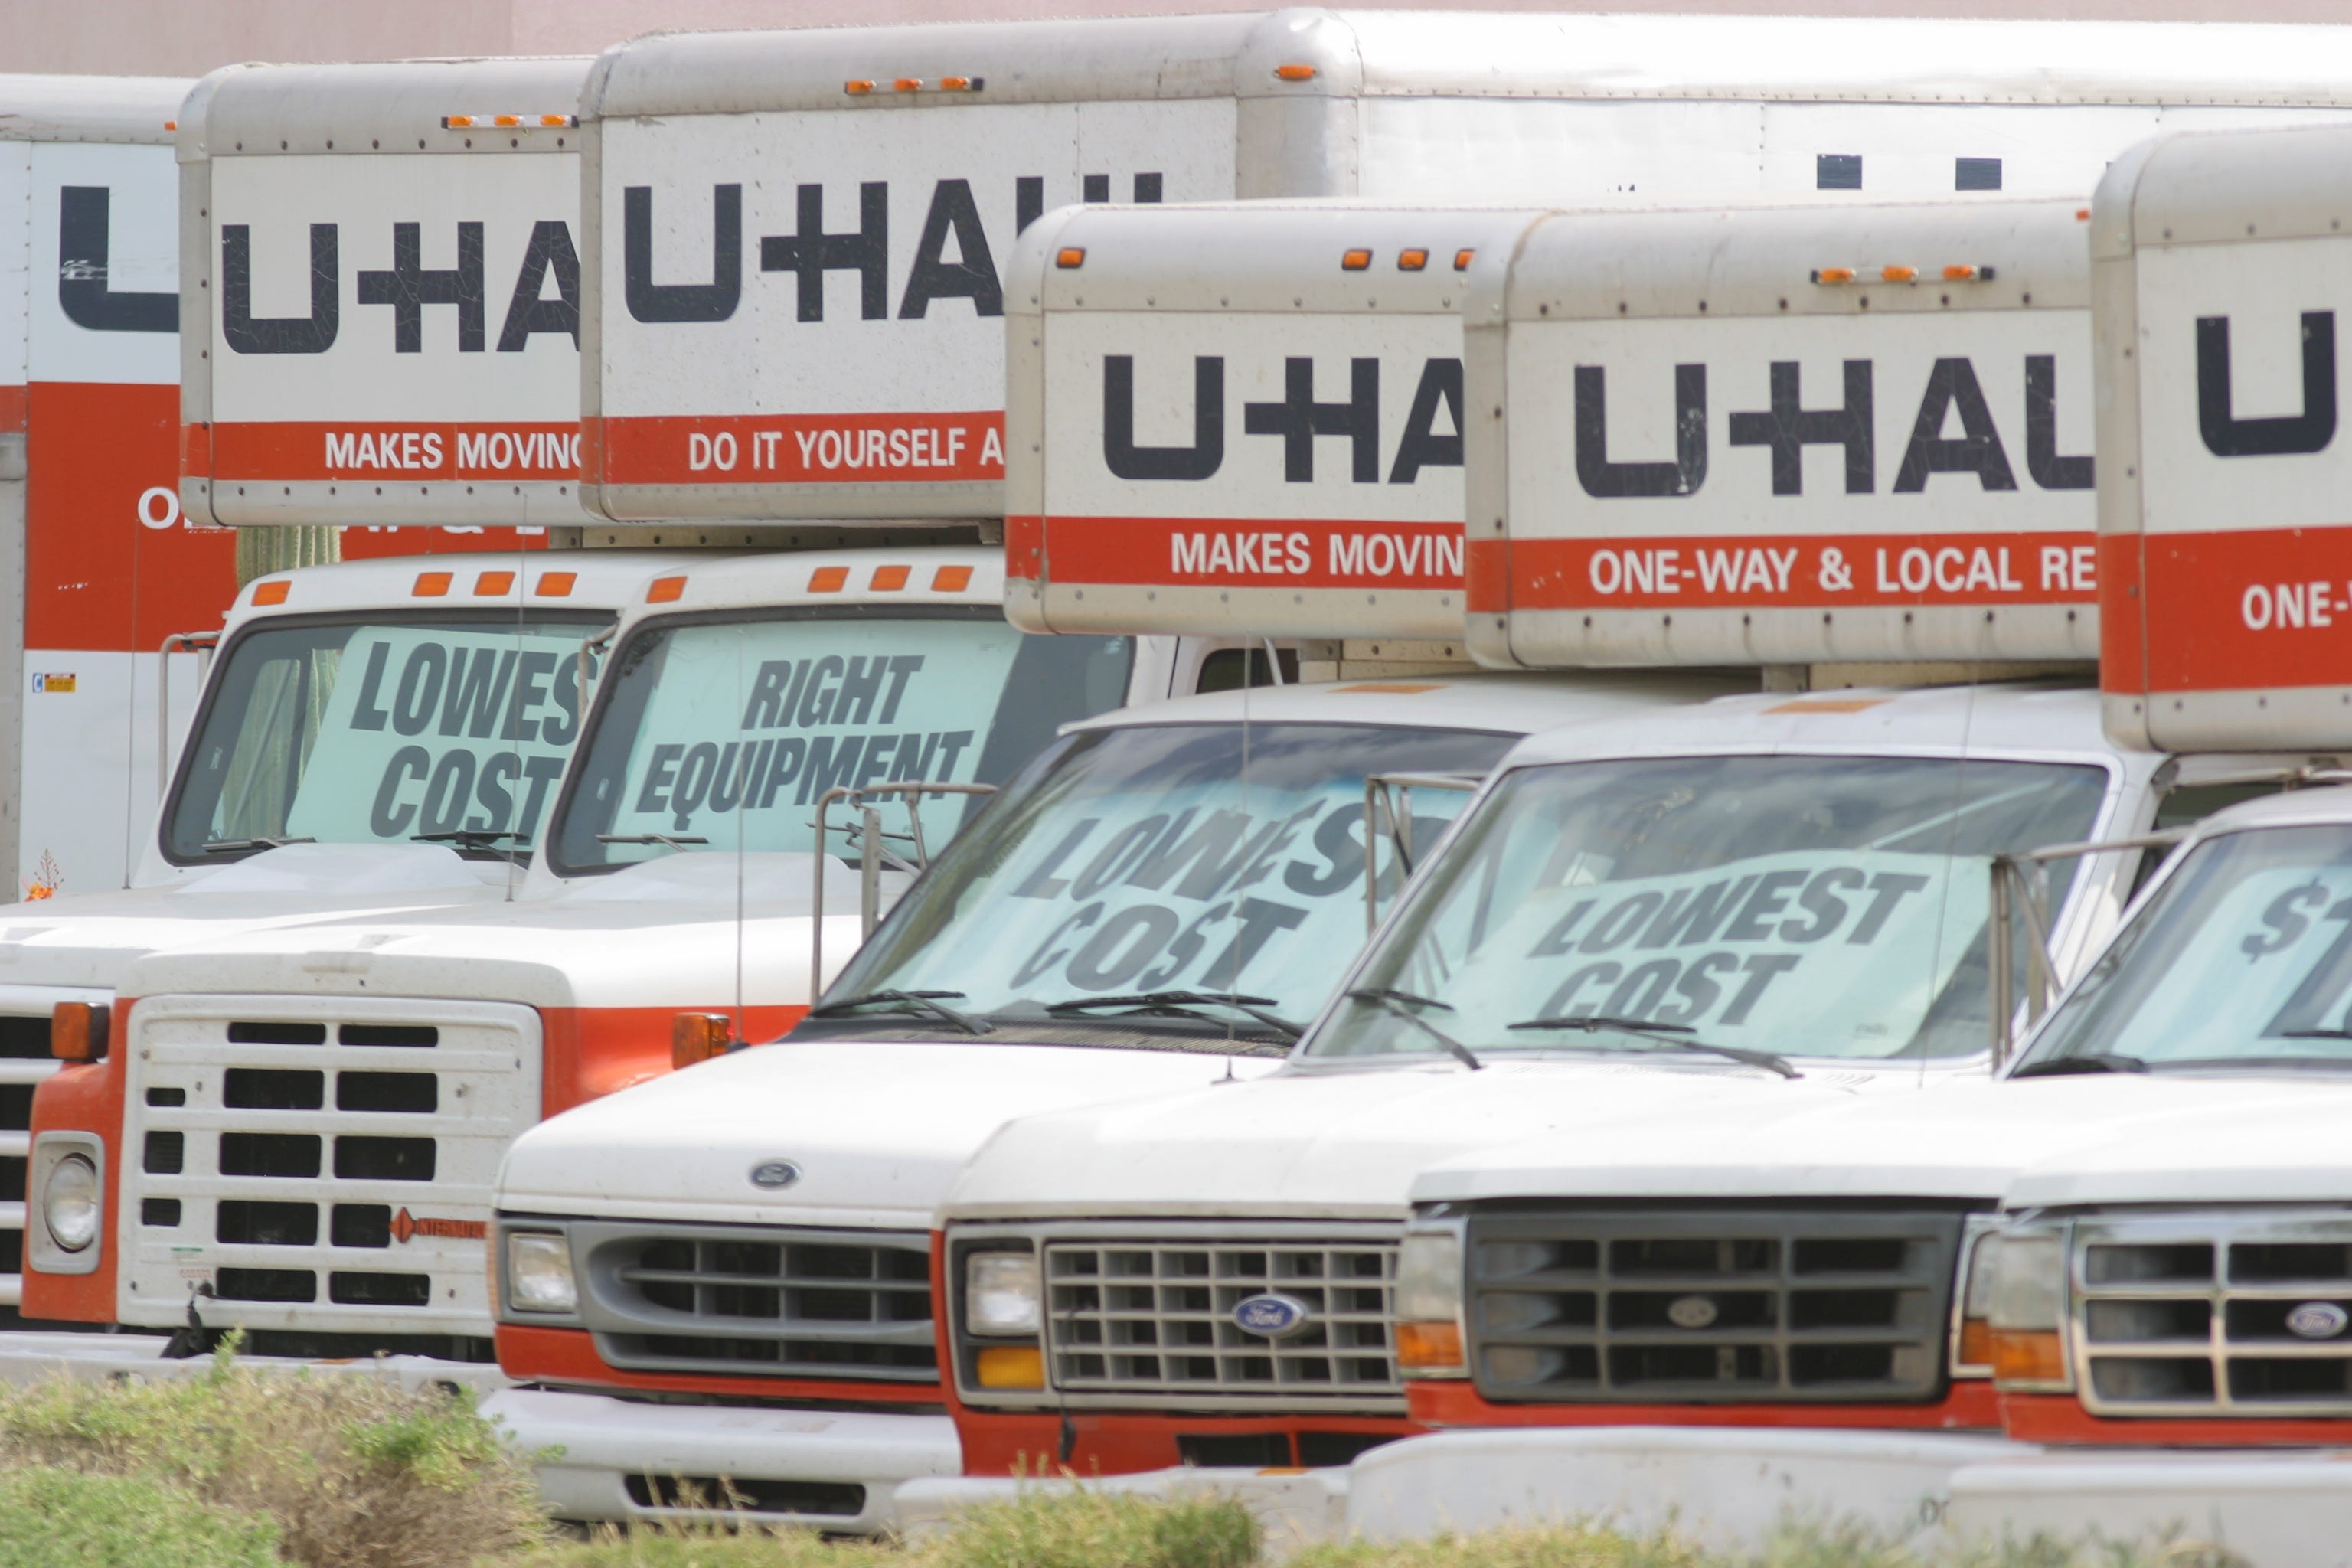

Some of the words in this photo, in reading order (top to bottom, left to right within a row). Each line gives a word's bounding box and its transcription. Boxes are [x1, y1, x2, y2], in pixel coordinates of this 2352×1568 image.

[624, 174, 1162, 323] U-HA
[325, 432, 443, 469] MAKES
[689, 432, 737, 471] DO
[753, 431, 782, 470] IT
[794, 427, 966, 469] YOURSELF
[1171, 532, 1311, 574] MAKES
[1329, 534, 1464, 577] MOVIN
[1589, 548, 1798, 594] ONE-WAY
[1818, 548, 1854, 591] &
[1877, 547, 2022, 593] LOCAL
[2041, 545, 2097, 591] RE
[2242, 580, 2352, 631] ONE-
[350, 642, 598, 746] LOWES
[741, 655, 925, 730] RIGHT
[370, 745, 567, 846] COST
[635, 730, 975, 831] EQUIPMENT
[1009, 897, 1310, 991] COST
[1527, 867, 1930, 959] LOWEST
[1535, 952, 1802, 1026] COST
